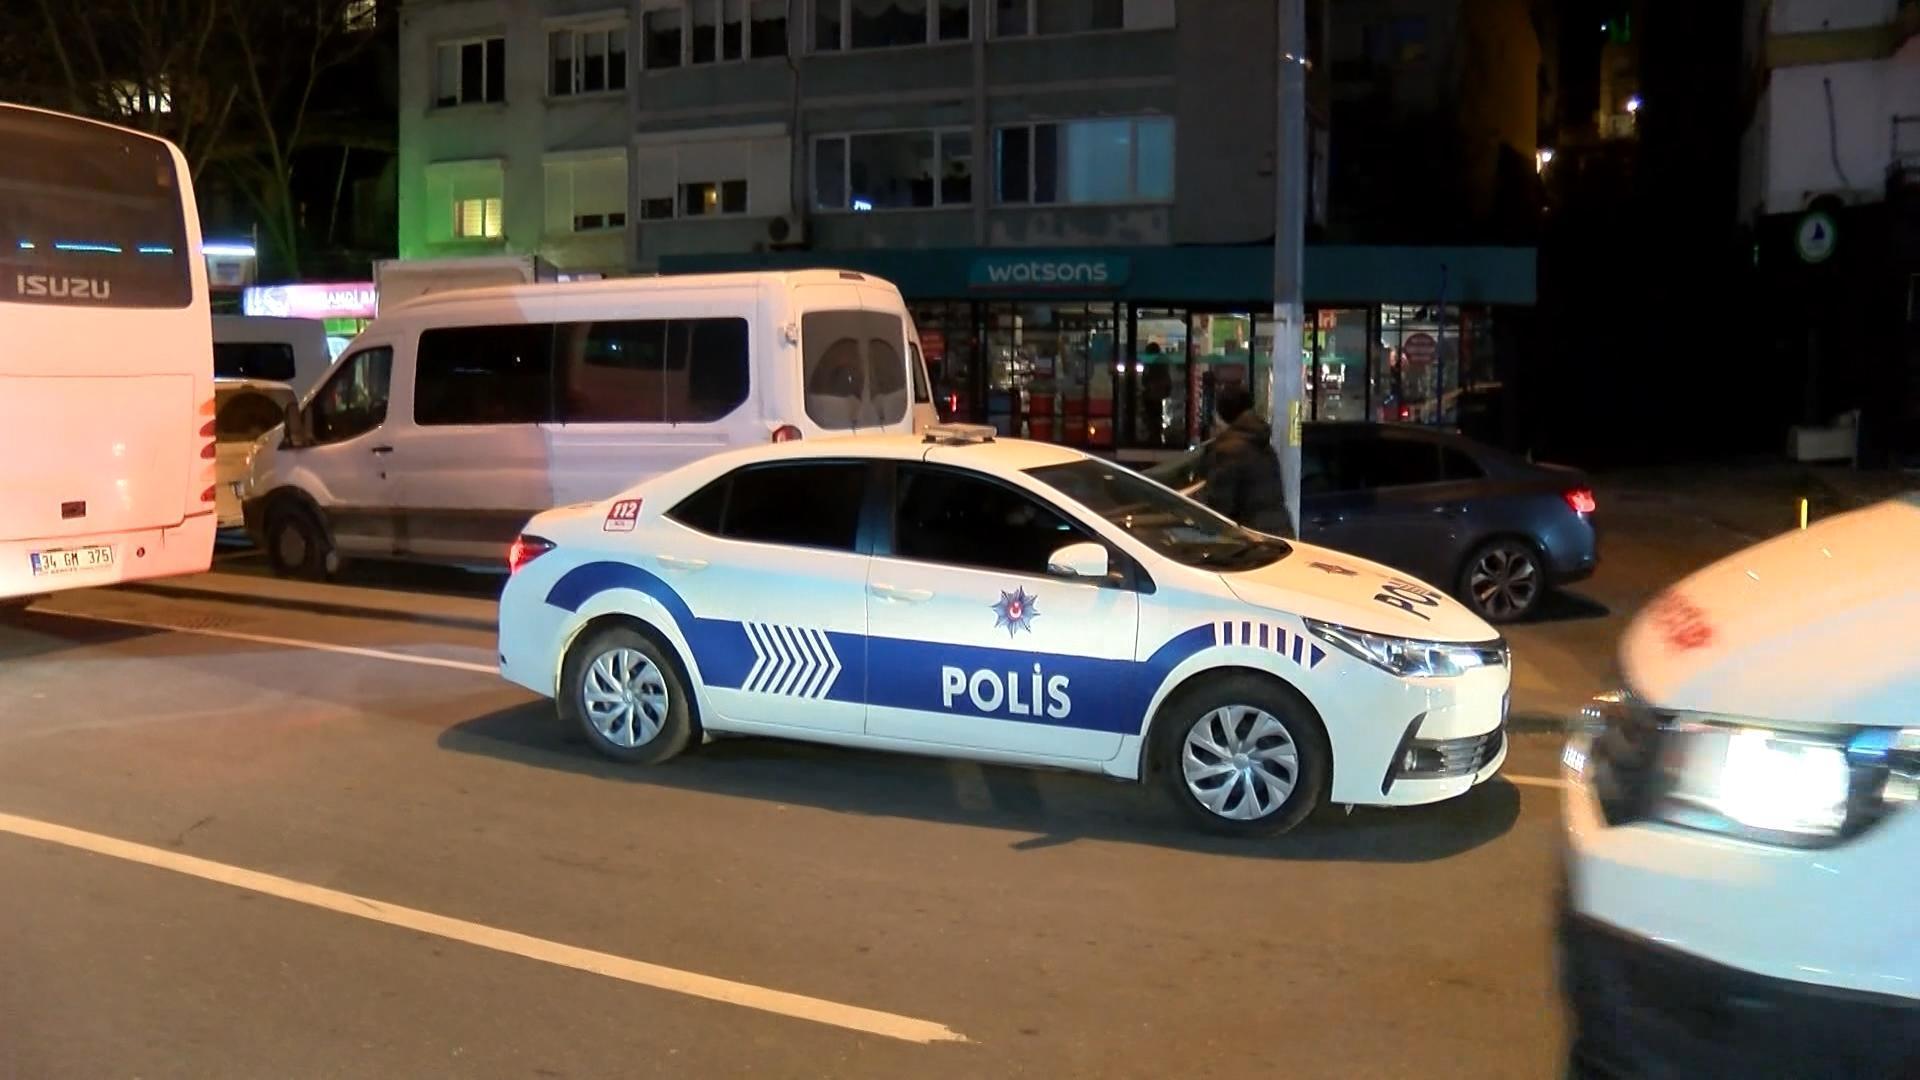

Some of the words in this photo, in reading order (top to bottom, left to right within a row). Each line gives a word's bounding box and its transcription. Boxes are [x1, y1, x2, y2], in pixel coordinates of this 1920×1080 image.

[987, 261, 1107, 281] watsons
[16, 275, 110, 298] ISUZU
[613, 502, 638, 518] 112
[42, 554, 57, 569] 34
[64, 552, 79, 567] GM
[88, 549, 109, 564] 375
[942, 662, 1071, 719] POLİS
